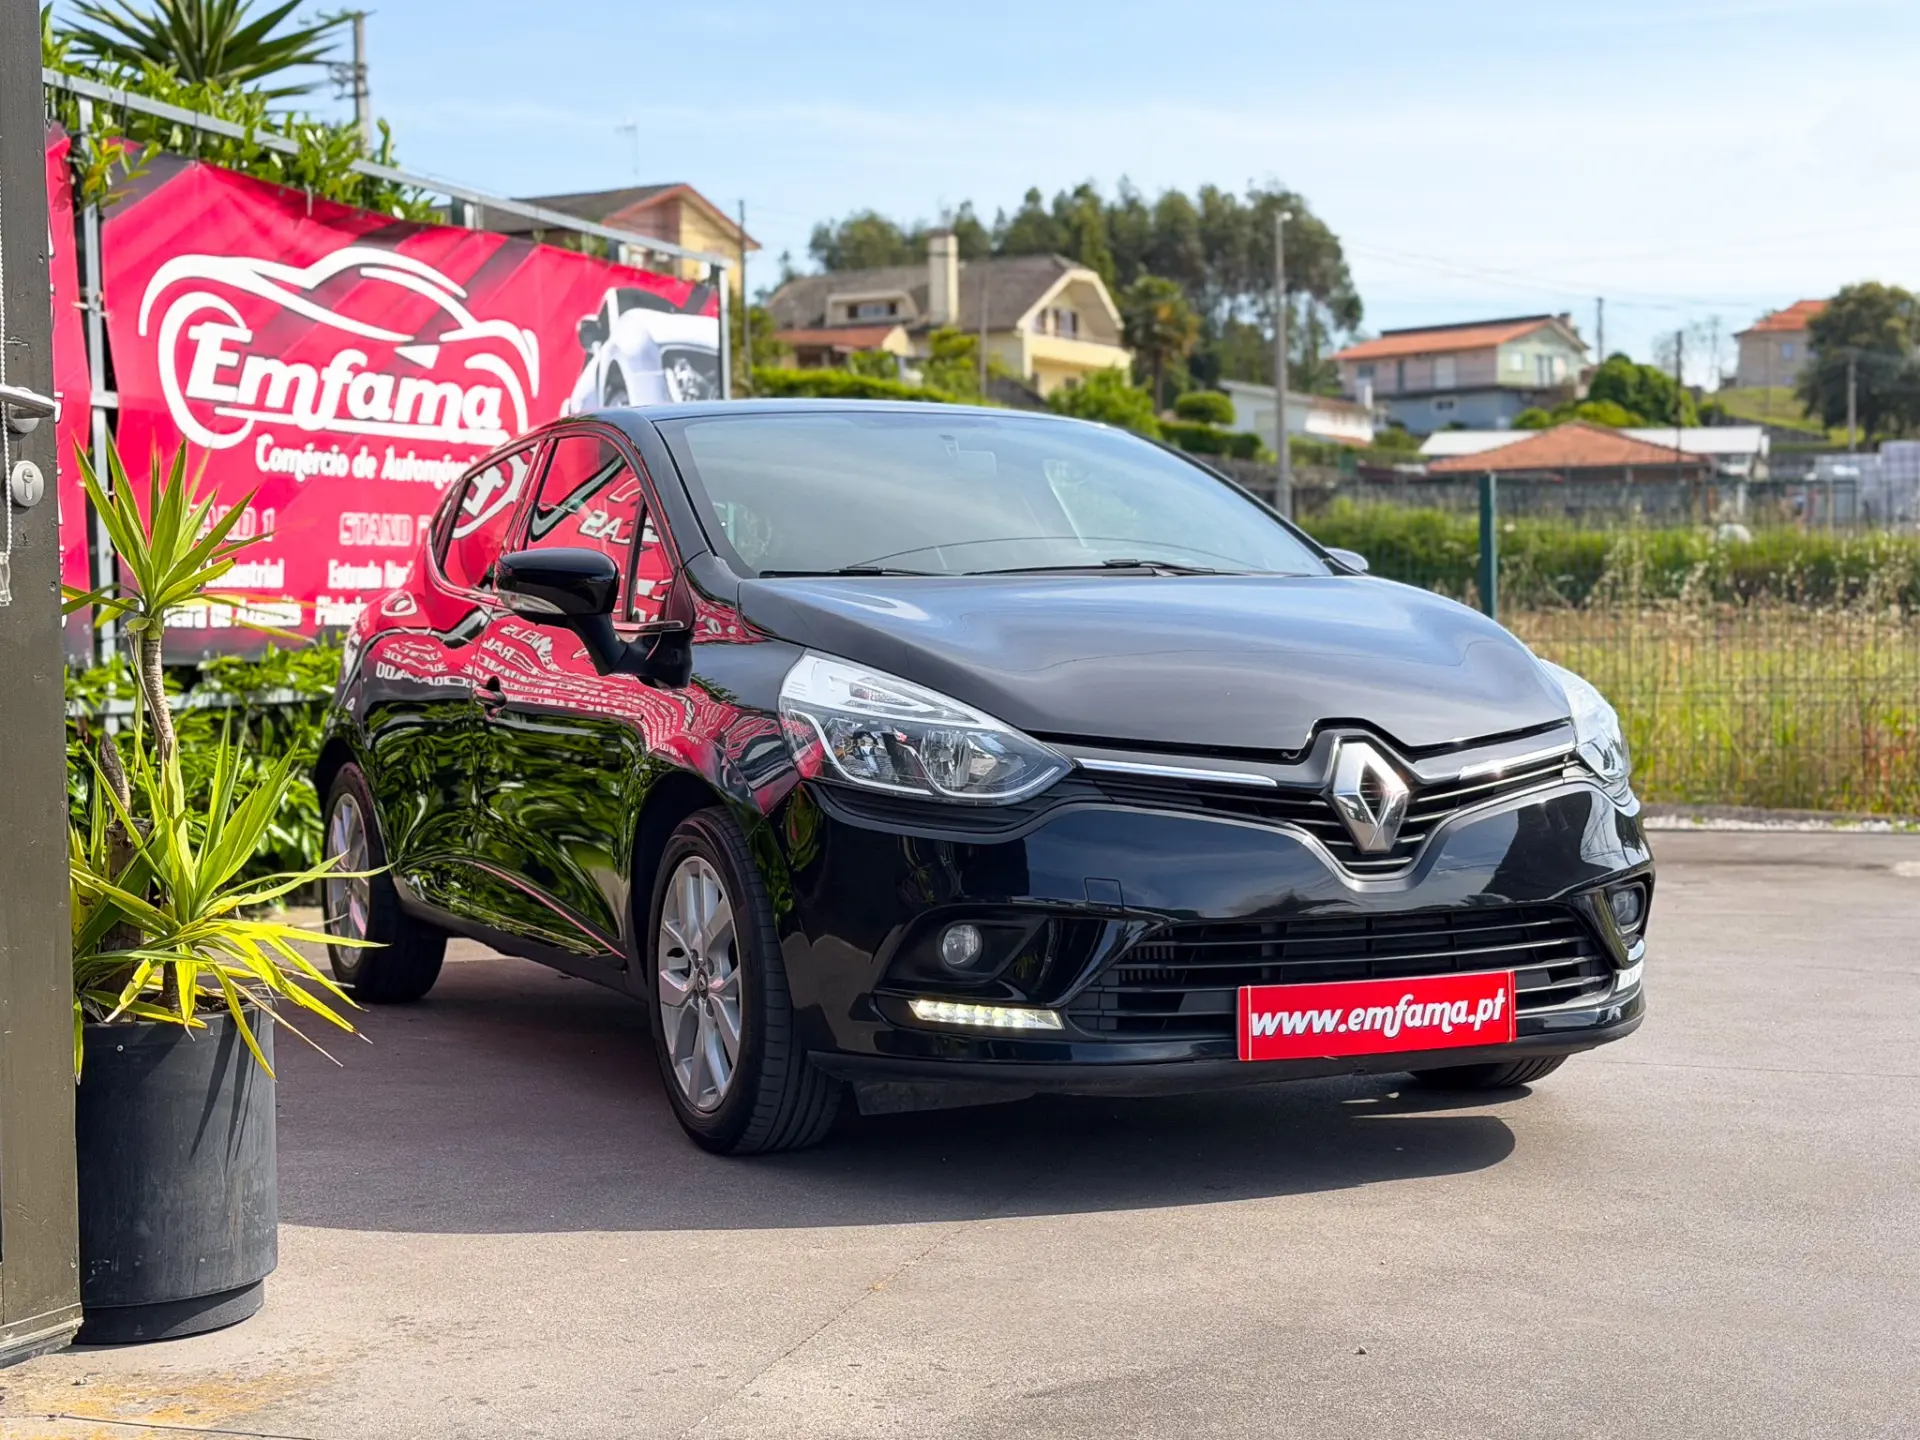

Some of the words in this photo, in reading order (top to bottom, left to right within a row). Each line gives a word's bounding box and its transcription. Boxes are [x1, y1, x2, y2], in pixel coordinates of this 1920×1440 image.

[186, 321, 503, 441] Emfama
[255, 434, 349, 482] Comércio
[351, 446, 378, 478] de
[339, 511, 414, 547] STAND
[1251, 987, 1506, 1038] www.emfama.pt
